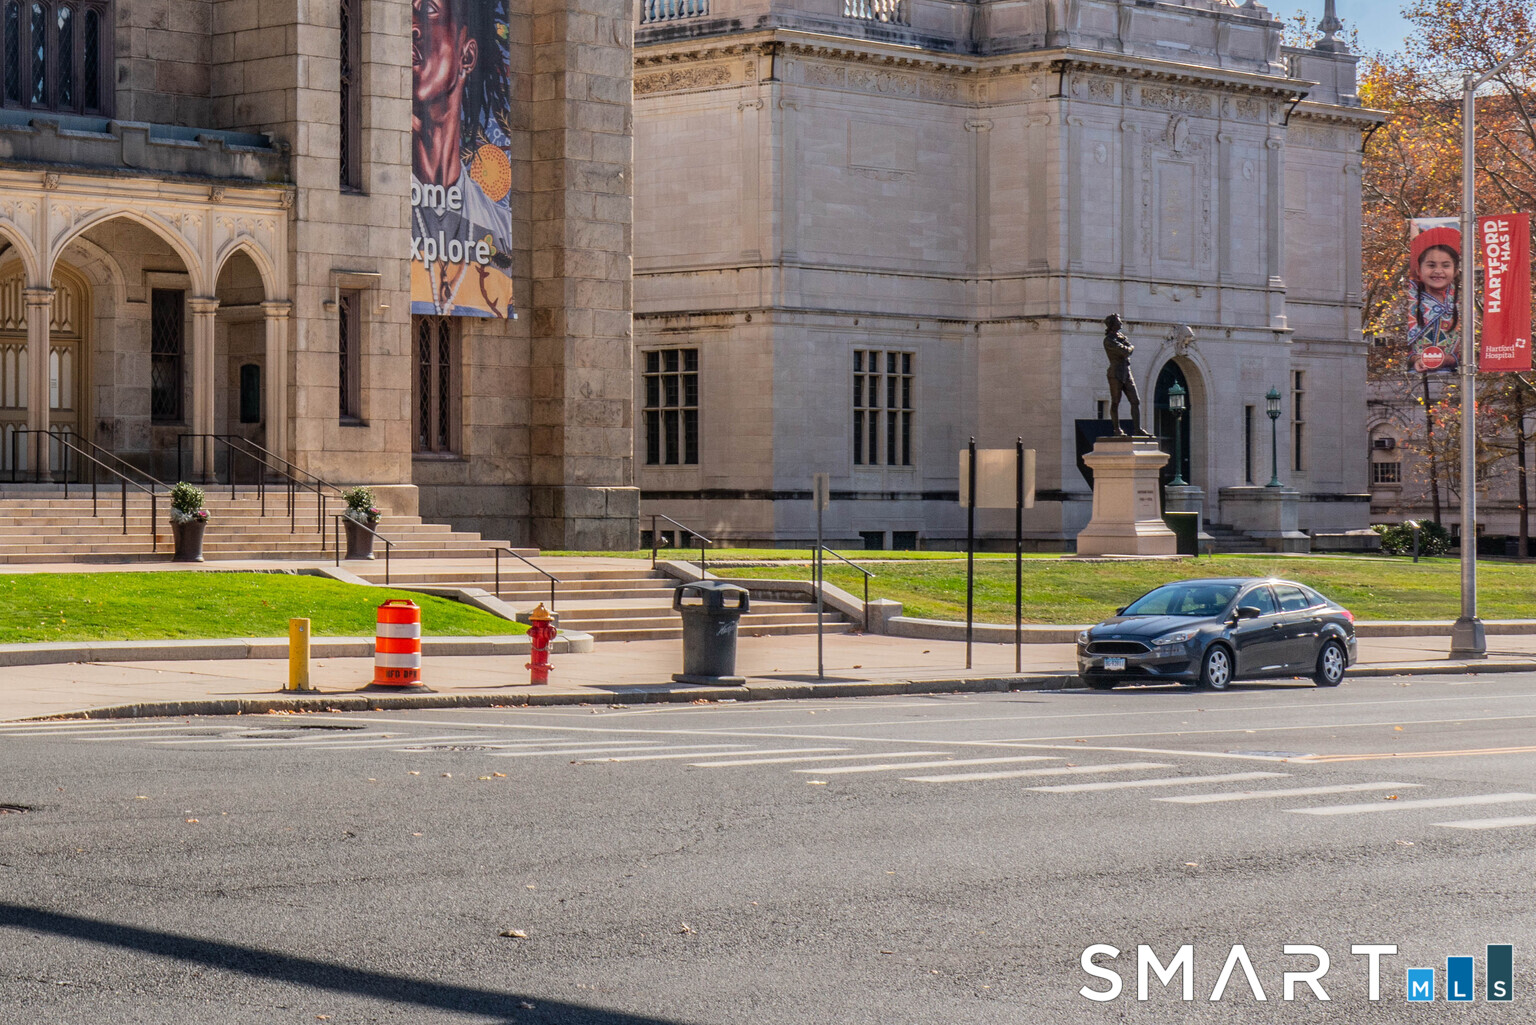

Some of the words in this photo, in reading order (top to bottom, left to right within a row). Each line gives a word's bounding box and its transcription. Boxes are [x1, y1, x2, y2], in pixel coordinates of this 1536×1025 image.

[1497, 219, 1509, 232] IT
[1500, 234, 1511, 261] HAS
[1483, 220, 1502, 313] HARTFORD
[1485, 344, 1515, 353] Hartford
[1485, 351, 1515, 361] Hospital
